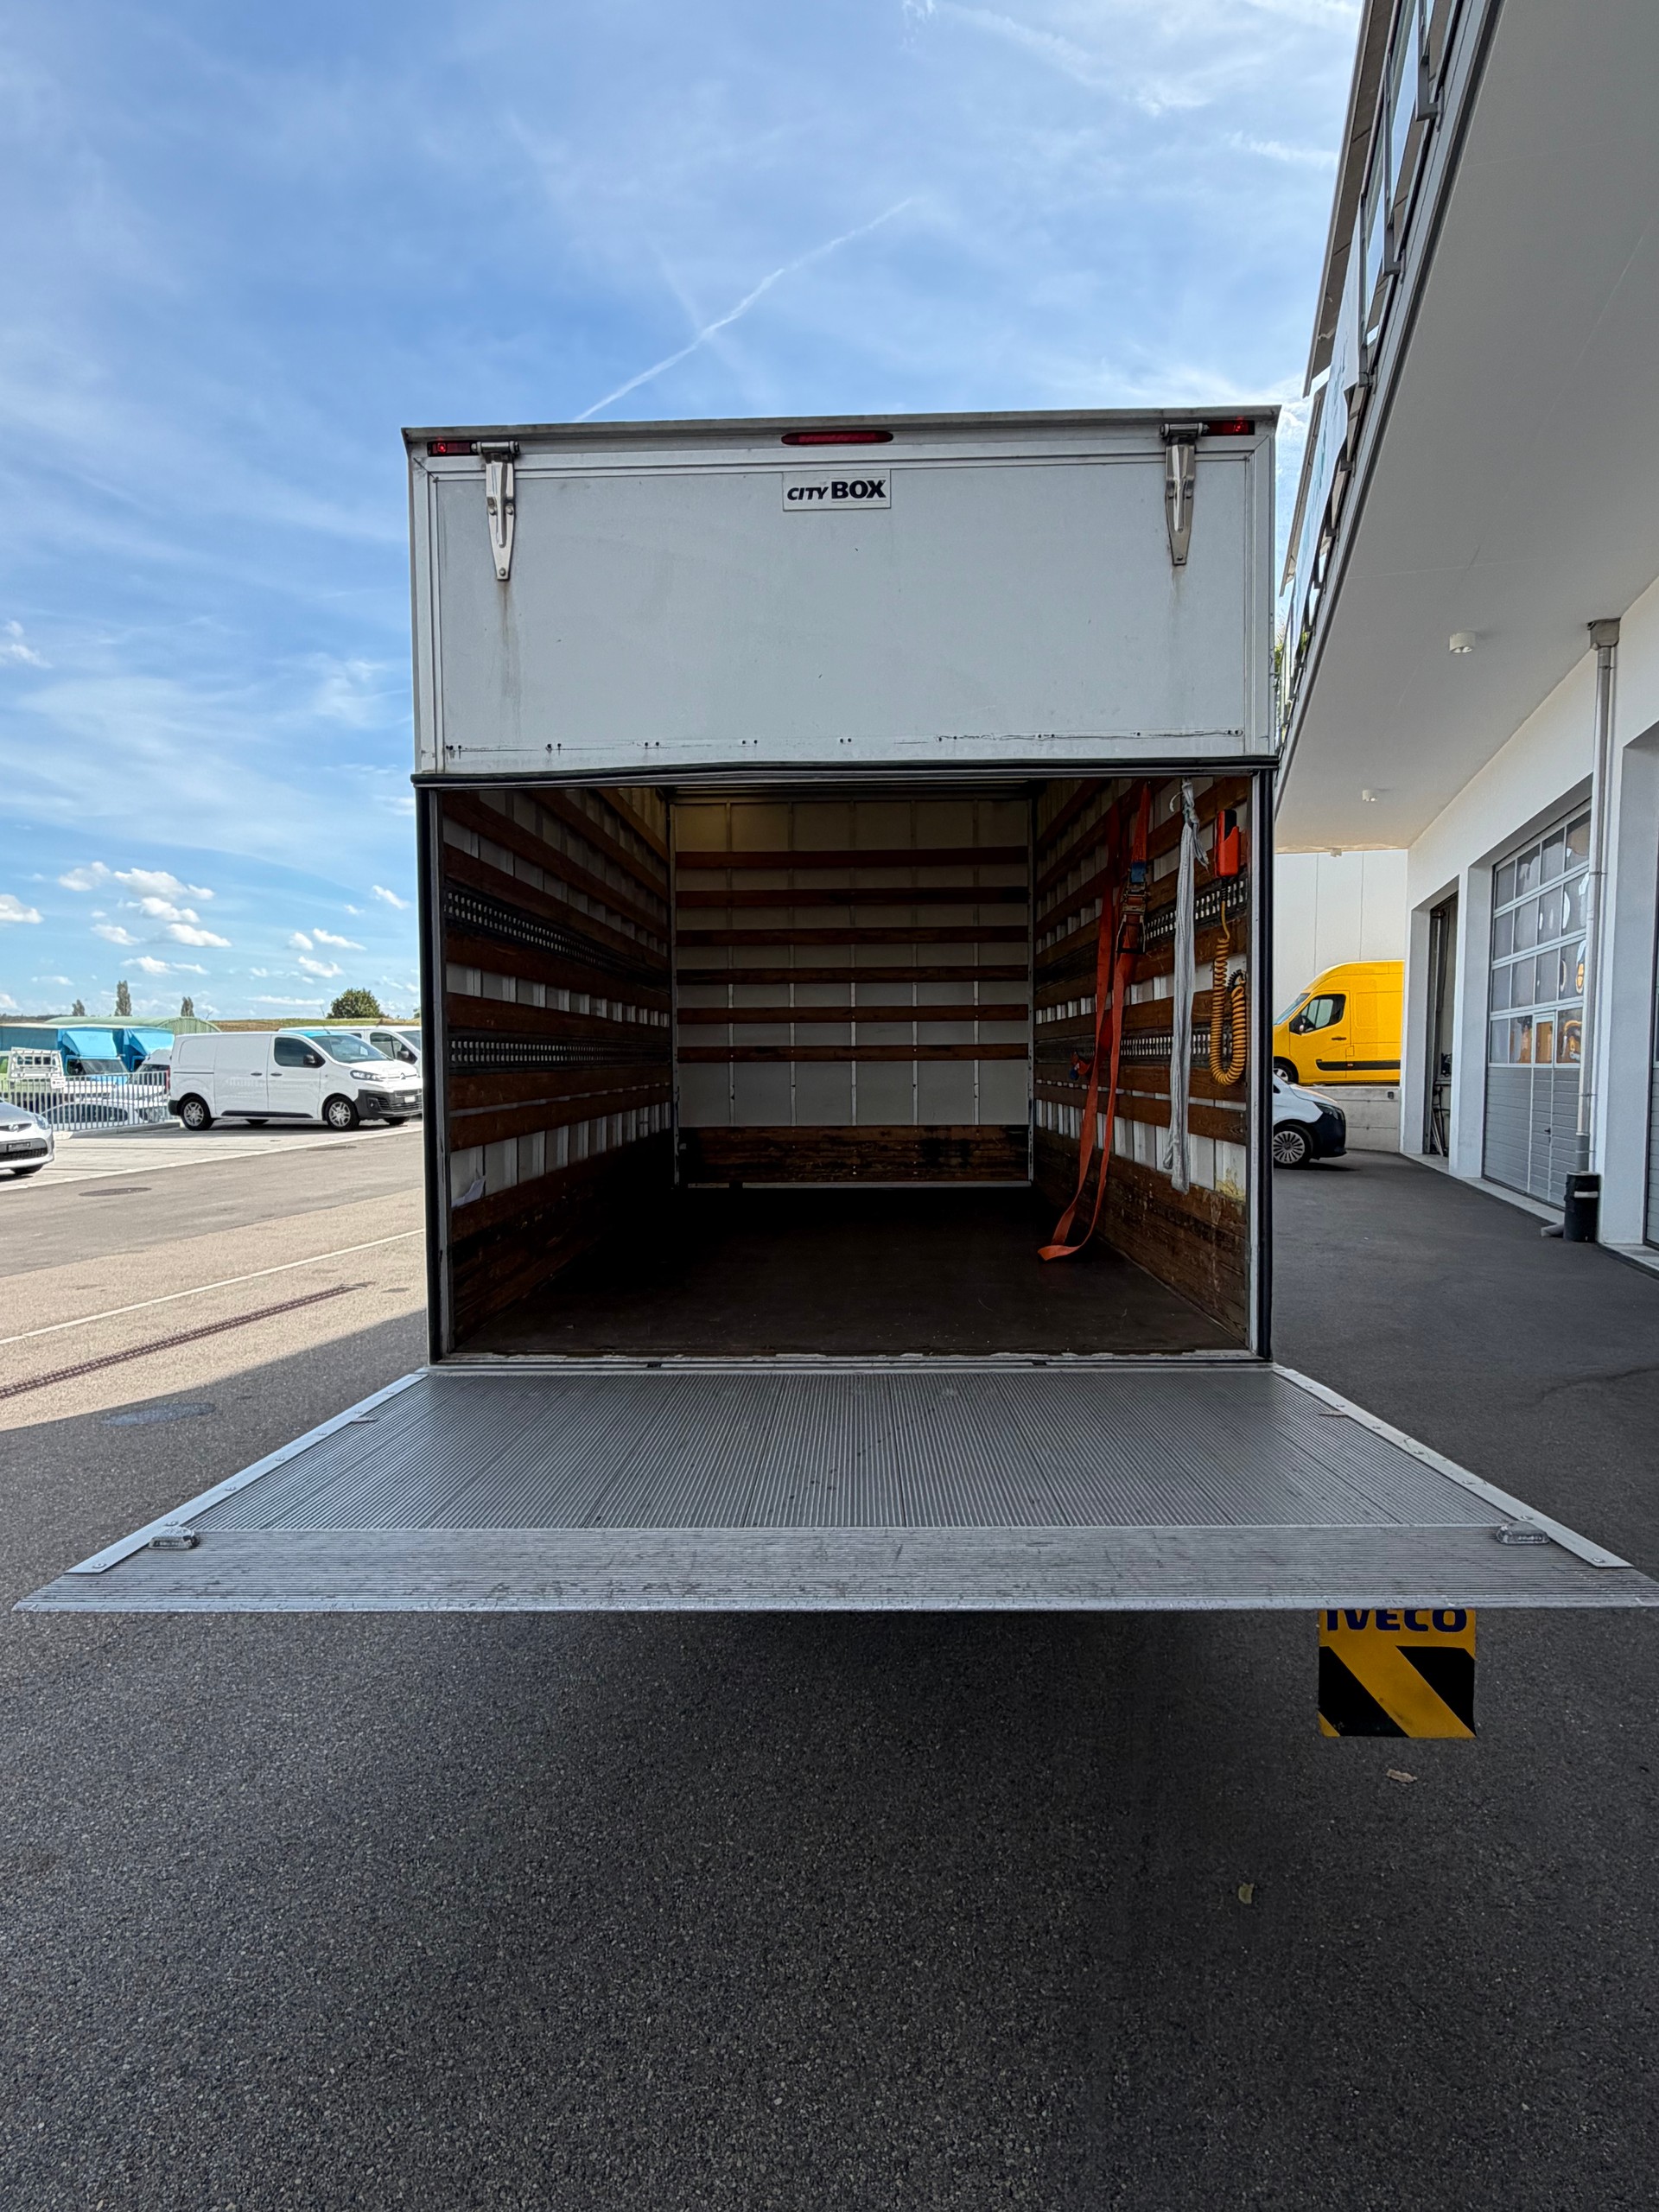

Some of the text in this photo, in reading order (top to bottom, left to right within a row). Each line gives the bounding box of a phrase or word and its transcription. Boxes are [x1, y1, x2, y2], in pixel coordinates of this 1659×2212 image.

[787, 480, 887, 500] CITY BOX
[1326, 1609, 1467, 1632] IVECO
